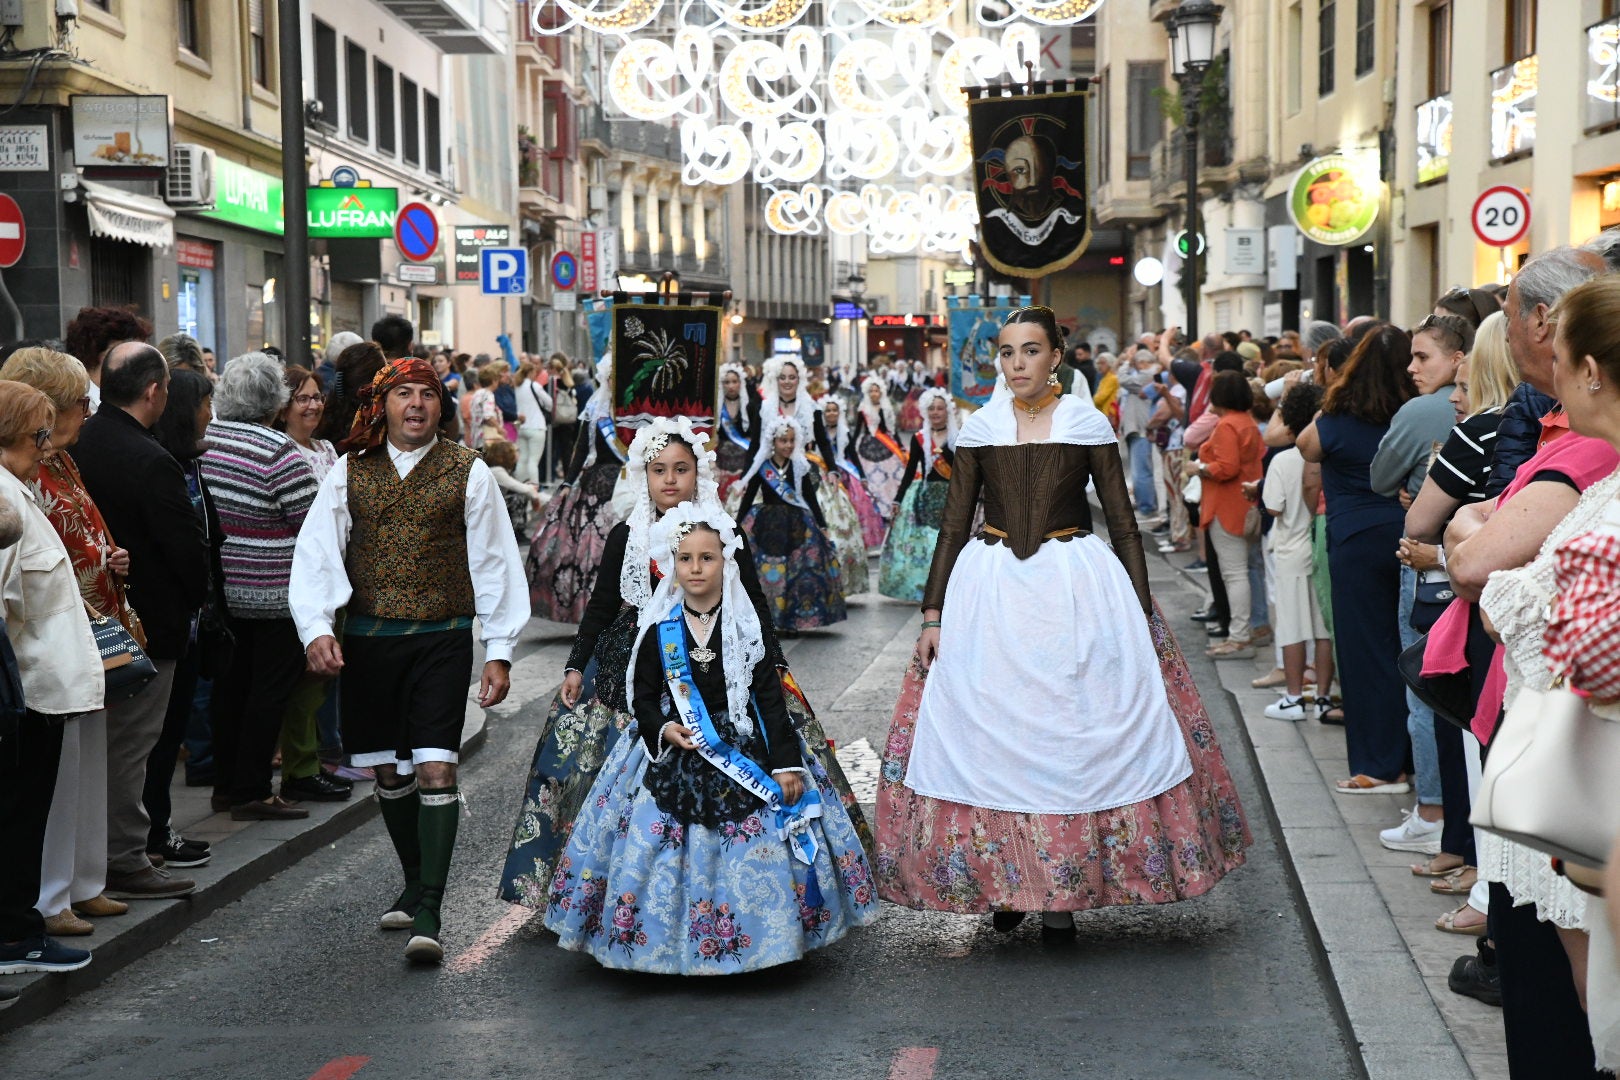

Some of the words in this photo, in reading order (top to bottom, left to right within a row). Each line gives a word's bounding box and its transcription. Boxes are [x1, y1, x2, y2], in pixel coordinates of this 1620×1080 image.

[225, 167, 268, 213] LUFRAN
[308, 210, 395, 228] LUFRAN
[1485, 206, 1518, 226] 20
[485, 229, 508, 240] ALC
[490, 253, 518, 290] P
[684, 706, 717, 759] Dama
